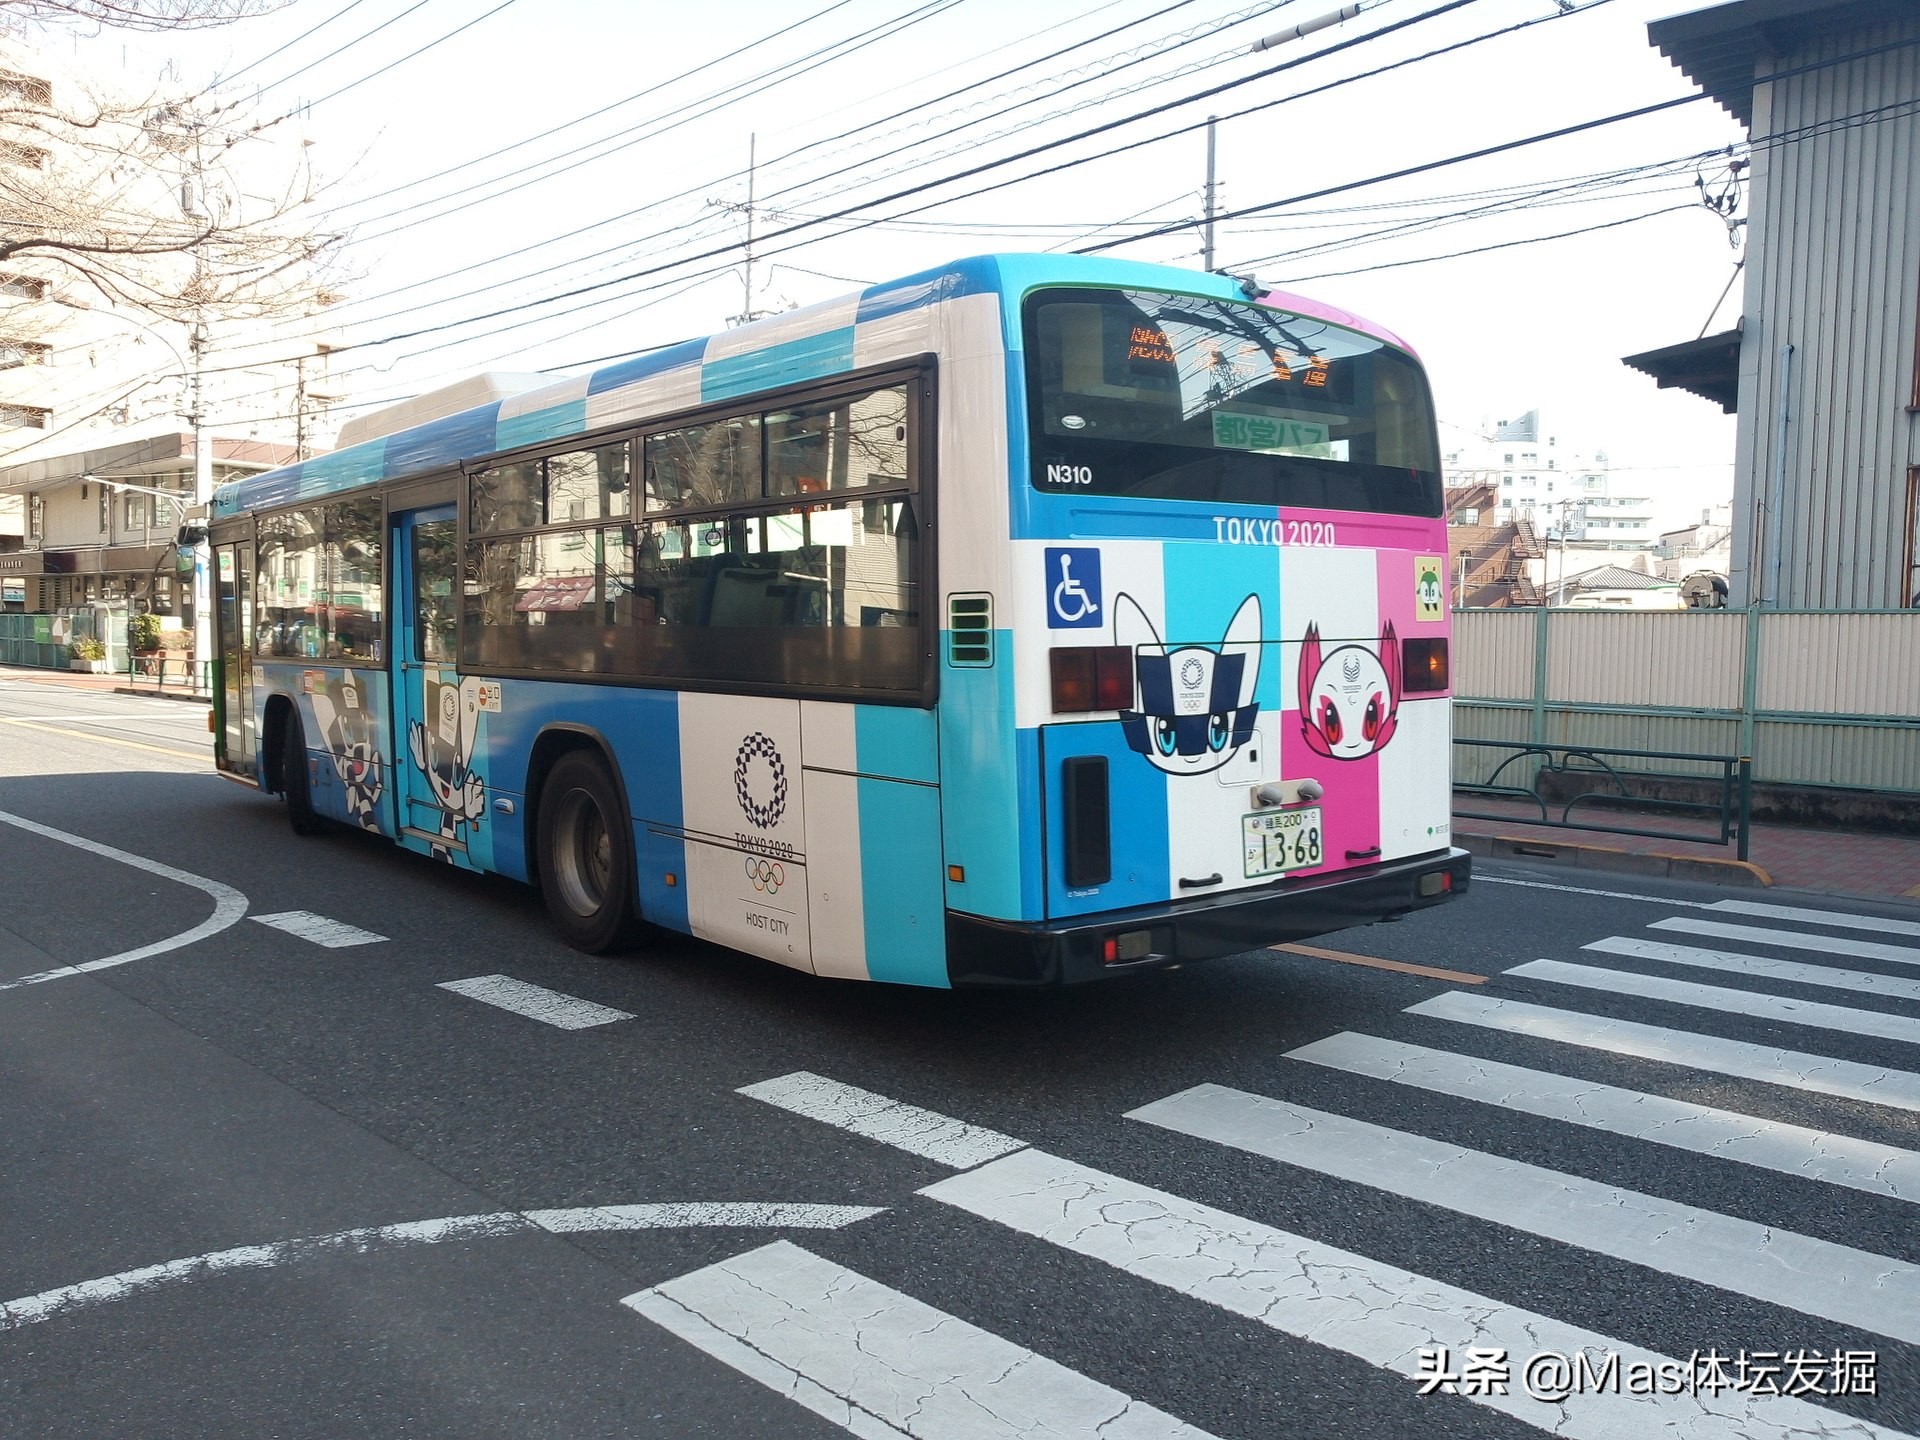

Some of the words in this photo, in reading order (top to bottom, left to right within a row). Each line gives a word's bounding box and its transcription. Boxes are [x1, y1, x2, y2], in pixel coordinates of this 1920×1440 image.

[1215, 415, 1330, 456] 都営バス
[1047, 464, 1093, 485] N310
[1213, 516, 1284, 546] TOKYO
[1287, 520, 1335, 548] 2020
[734, 832, 767, 854] TOKYO
[768, 839, 793, 859] 2020
[745, 912, 769, 930] HOST
[770, 918, 789, 935] CITY
